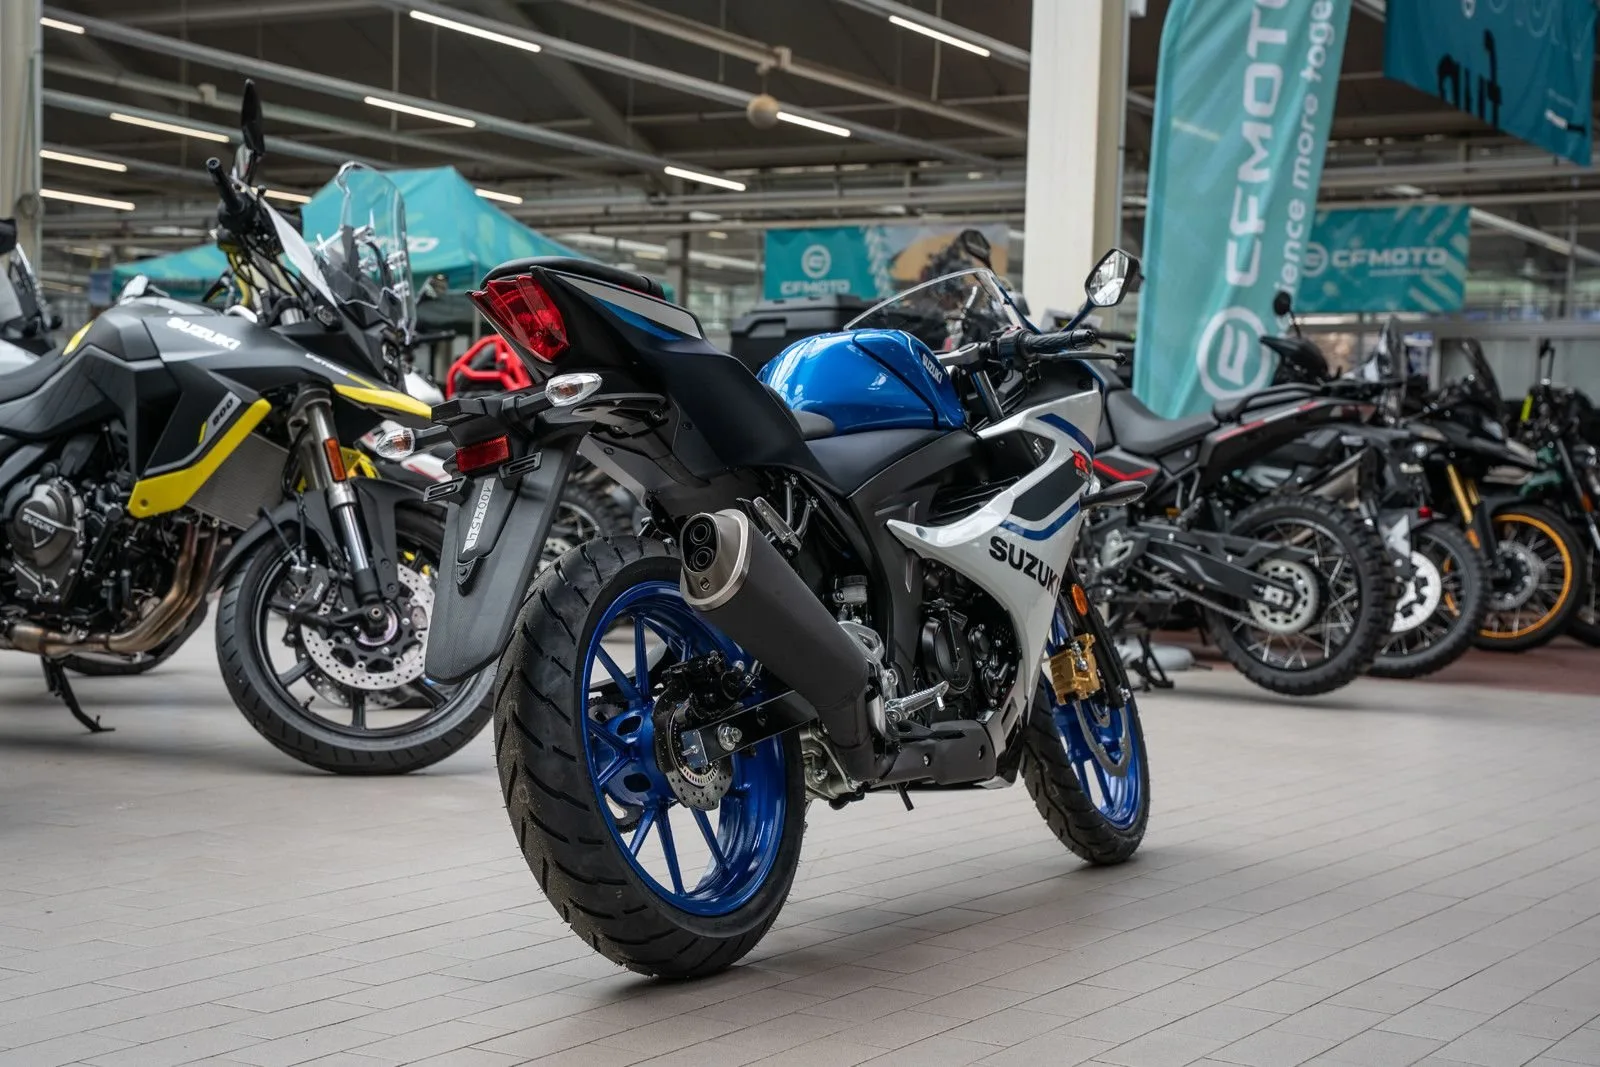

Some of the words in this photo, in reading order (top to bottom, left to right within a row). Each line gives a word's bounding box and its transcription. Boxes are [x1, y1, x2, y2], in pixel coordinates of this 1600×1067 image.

[1225, 0, 1288, 287] CFMOT
[1292, 93, 1318, 190] more
[1331, 246, 1448, 268] CFMOTO
[780, 279, 851, 296] CFMOTO
[166, 316, 241, 350] SUZUKI
[922, 353, 943, 384] SUZUKI
[22, 513, 56, 535] SUZUKI
[988, 535, 1060, 600] SUZUKI
